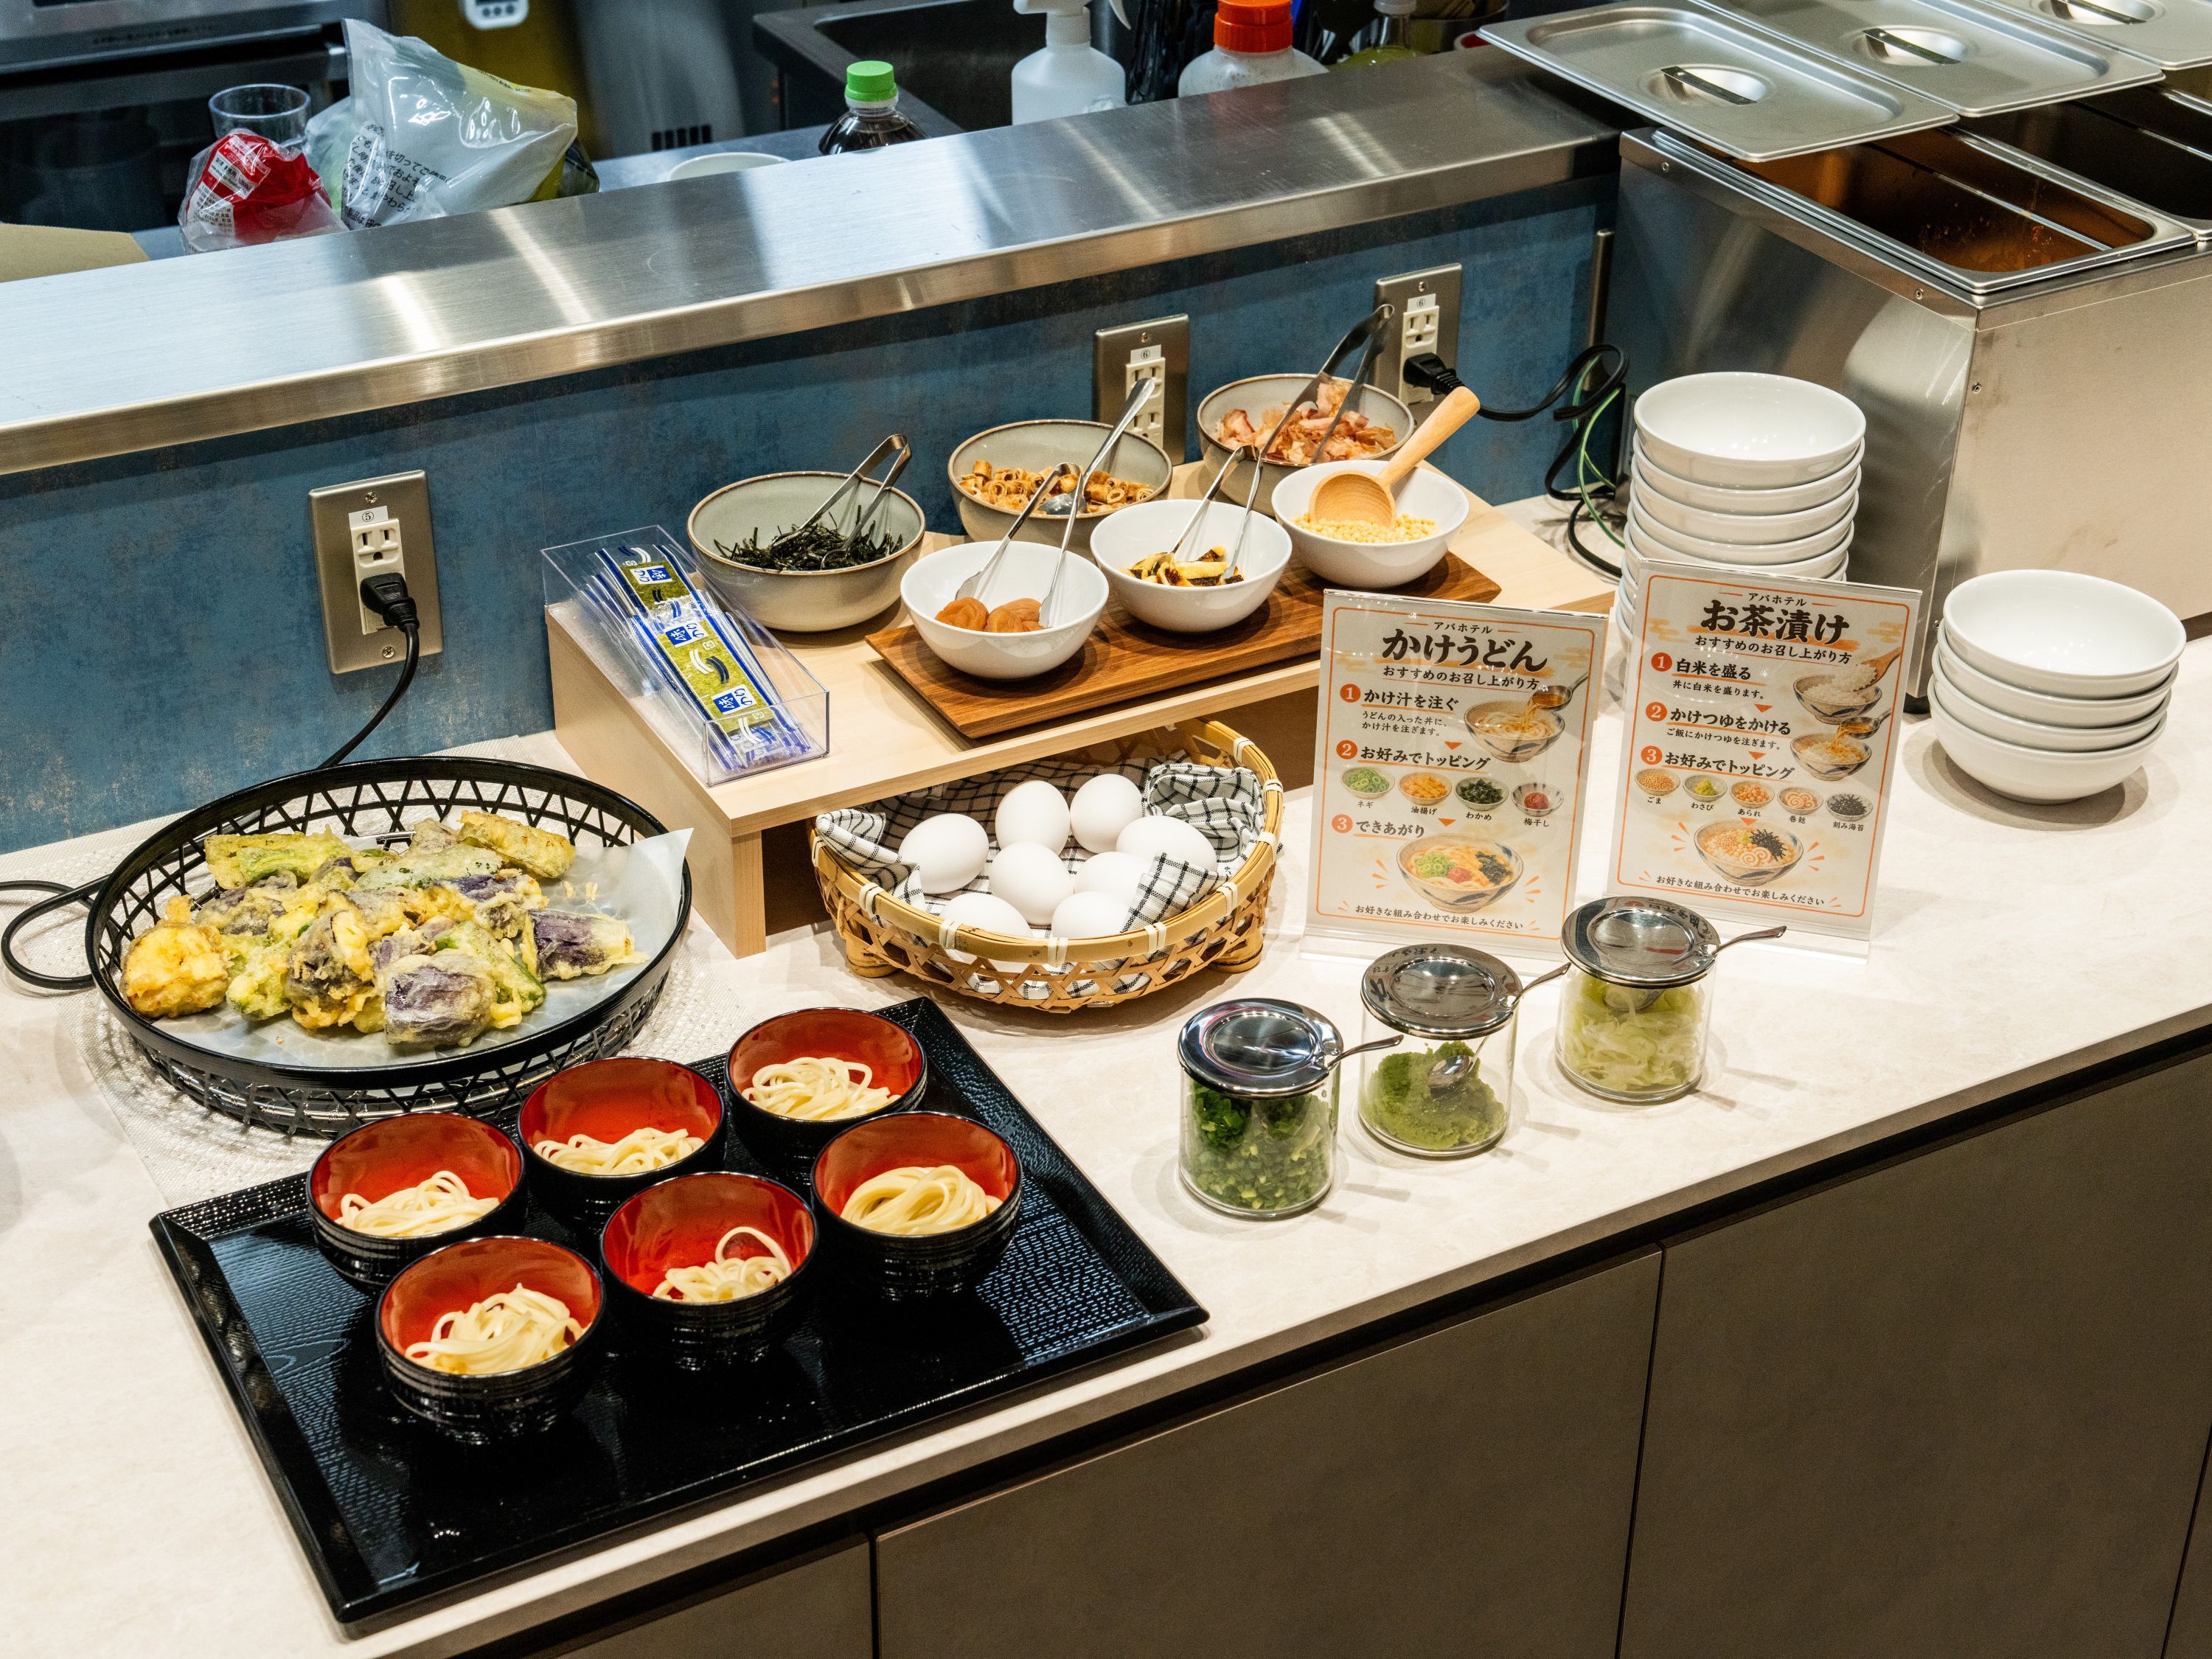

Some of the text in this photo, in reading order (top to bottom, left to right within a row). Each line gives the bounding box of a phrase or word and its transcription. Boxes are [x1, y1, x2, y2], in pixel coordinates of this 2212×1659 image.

[1748, 593, 1807, 607] アパホテル
[1434, 622, 1493, 634] アパホテル
[1700, 599, 1851, 645] お茶漬け
[1382, 628, 1548, 672] かけうどん
[1695, 635, 1852, 664] おすすめのお召し上がり方
[1382, 665, 1540, 690] おすすめのお召し上がり方
[1676, 658, 1751, 681] 白米を盛る
[1672, 680, 1764, 700] 丼に白米を盛ります。
[1364, 689, 1458, 712] かけ汁を注ぐ
[1362, 711, 1447, 727] うどんの入った丼に、
[1670, 708, 1791, 735] かけつゆをかける
[1362, 722, 1440, 737] かけ汁を注ぎます。
[1666, 728, 1781, 751] ご飯にかけつゆを注ぎます。
[1360, 746, 1491, 770] お好みでトッピング
[1665, 751, 1795, 779] お好みでトッピング
[1357, 800, 1374, 809] ネギ
[1647, 796, 1661, 804] ごま
[1691, 802, 1714, 811] わさび
[1411, 806, 1437, 815] 油揚げ
[1465, 811, 1492, 821] わかめ
[1738, 808, 1761, 818] あられ
[1356, 820, 1425, 838] できあがり
[1523, 818, 1550, 827] 梅干し
[1832, 821, 1865, 832] 刻み海苔
[1656, 875, 1825, 905] お好きな組み合わせでお楽しみください
[1355, 905, 1523, 929] お好きな組み合わせでお楽しみください
